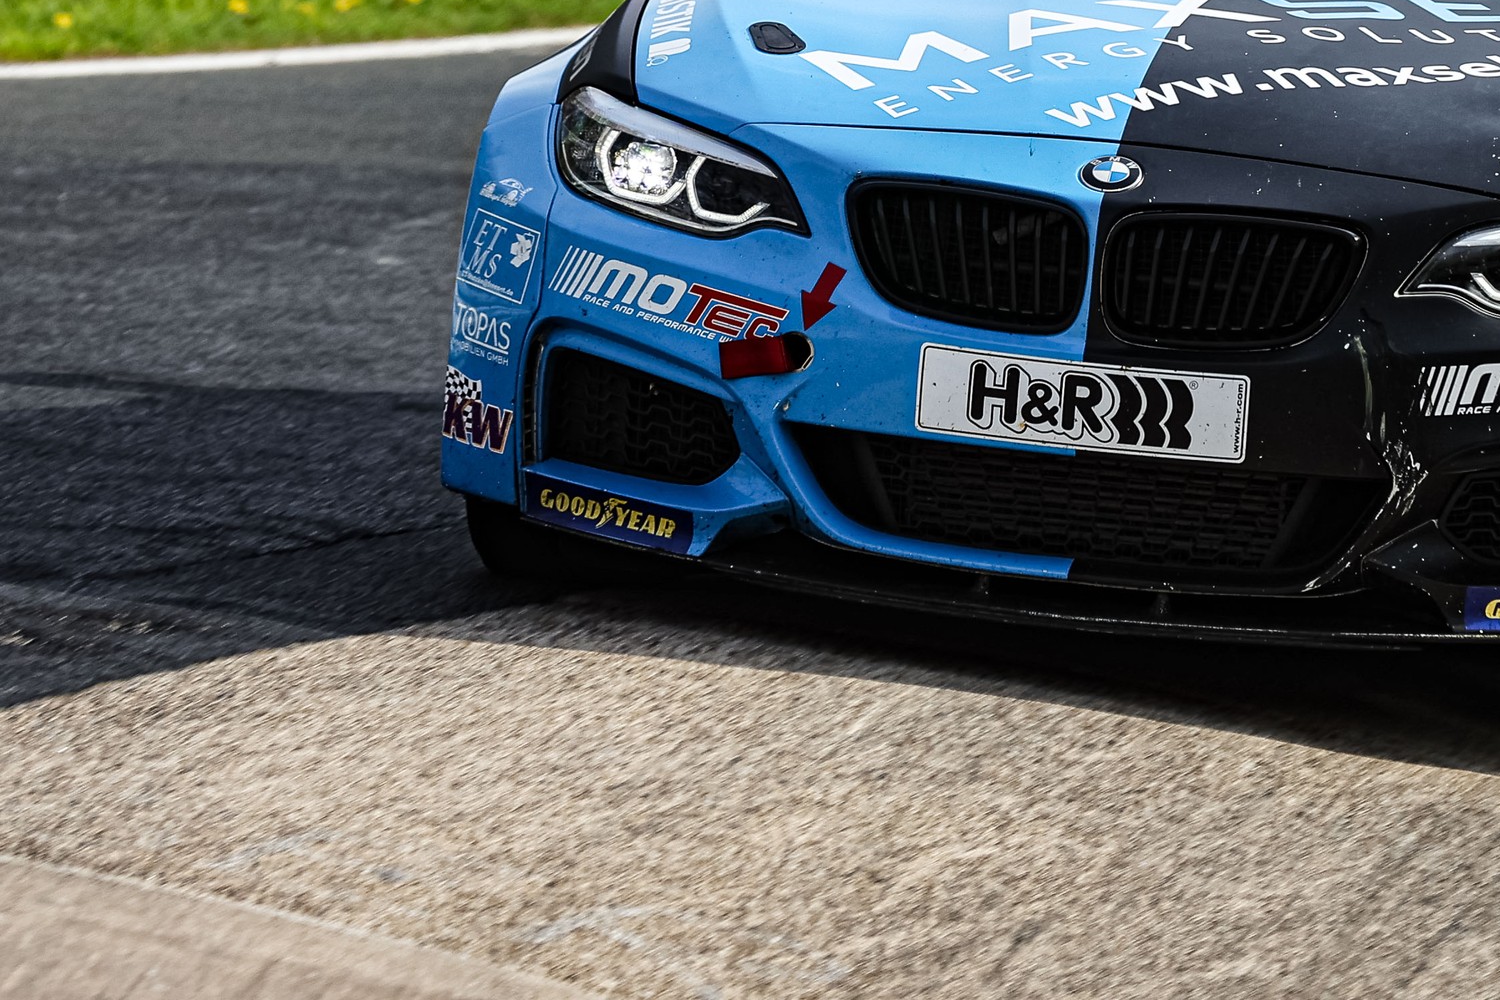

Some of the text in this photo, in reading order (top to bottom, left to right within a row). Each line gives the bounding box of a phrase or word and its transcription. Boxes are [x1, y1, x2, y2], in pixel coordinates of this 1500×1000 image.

[873, 33, 1194, 119] ENERGY
[1090, 155, 1139, 169] BMW
[473, 219, 508, 251] ET
[466, 246, 502, 279] MS
[582, 294, 610, 308] RACE
[612, 304, 635, 316] AND
[636, 310, 717, 341] PERFORMANCE
[968, 361, 1108, 439] H&R
[1233, 383, 1244, 454] www.h-r.com
[1457, 405, 1491, 416] RACE
[443, 393, 513, 455] KW
